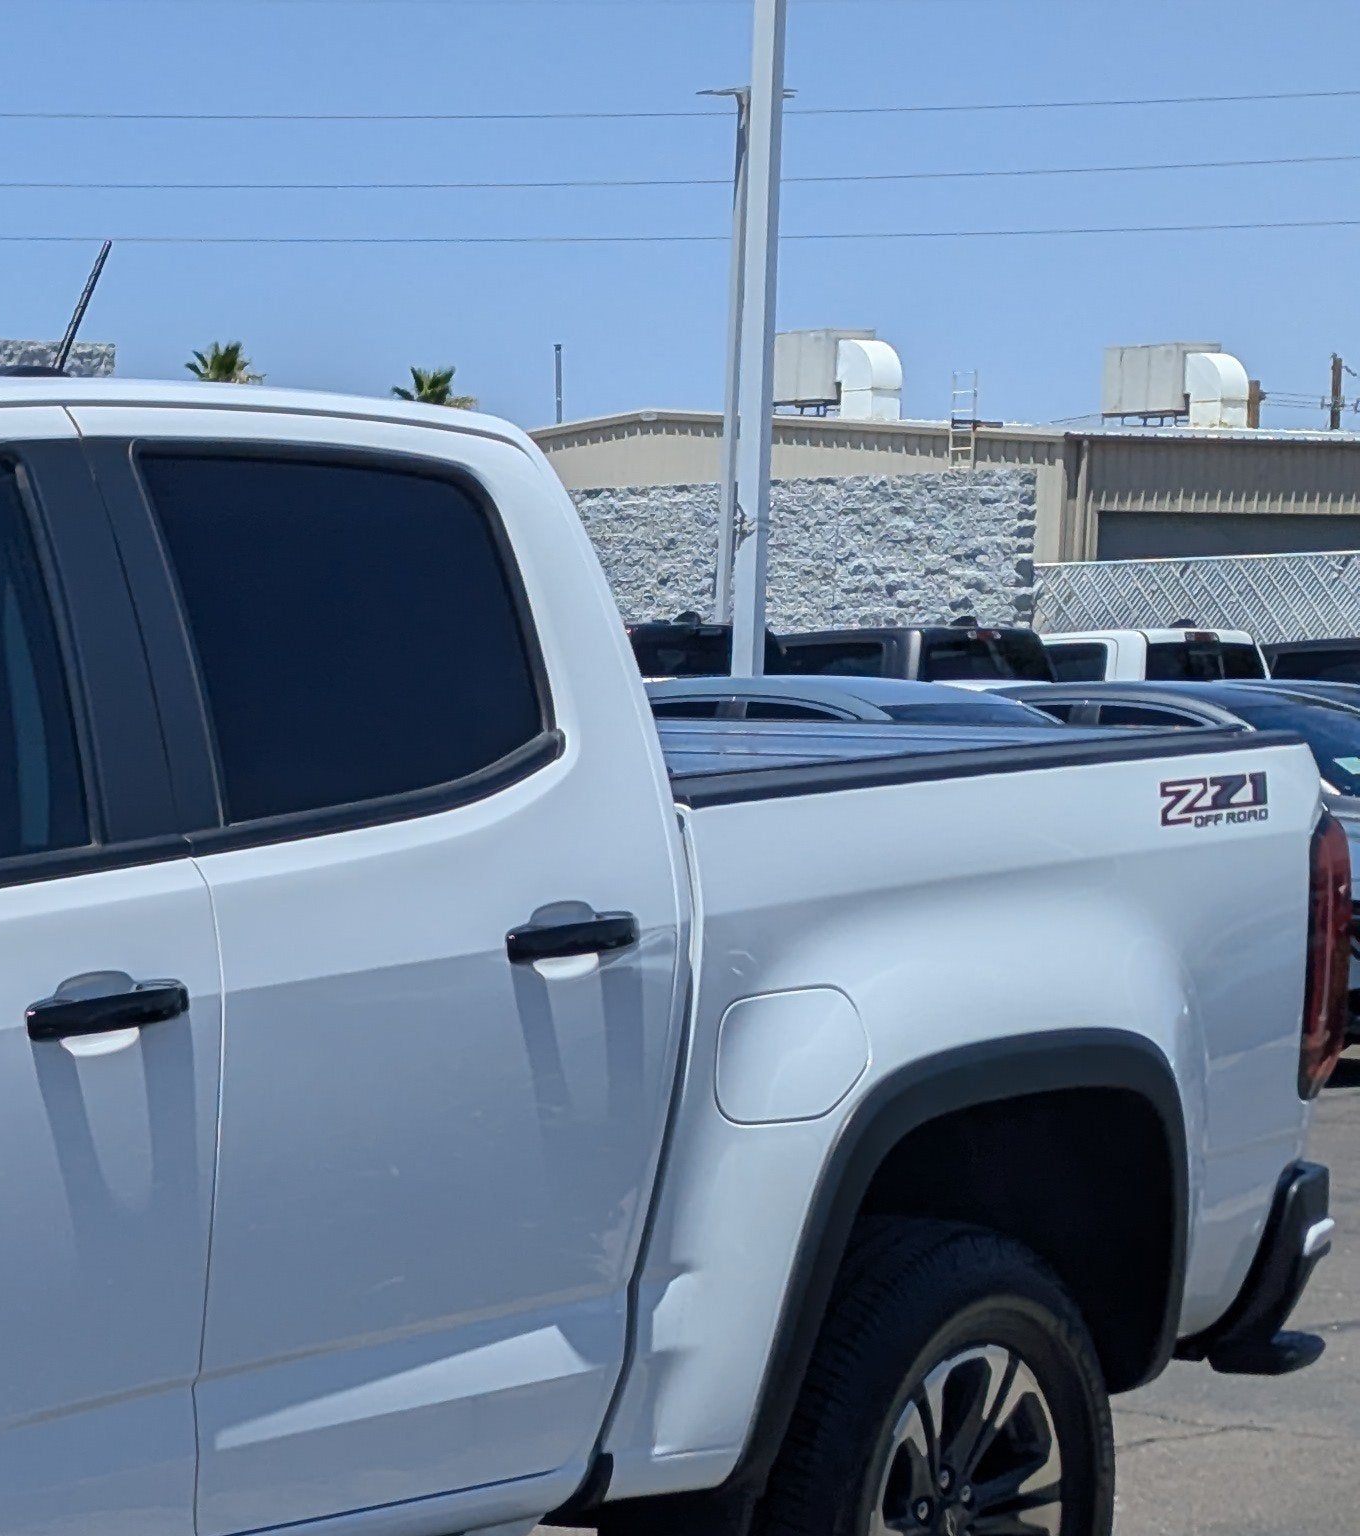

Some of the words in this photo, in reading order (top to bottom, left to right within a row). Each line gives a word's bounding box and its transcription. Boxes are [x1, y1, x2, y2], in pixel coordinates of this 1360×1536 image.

[1160, 771, 1268, 827] Z71
[1194, 812, 1224, 828] OFF
[1225, 808, 1269, 825] ROAD
